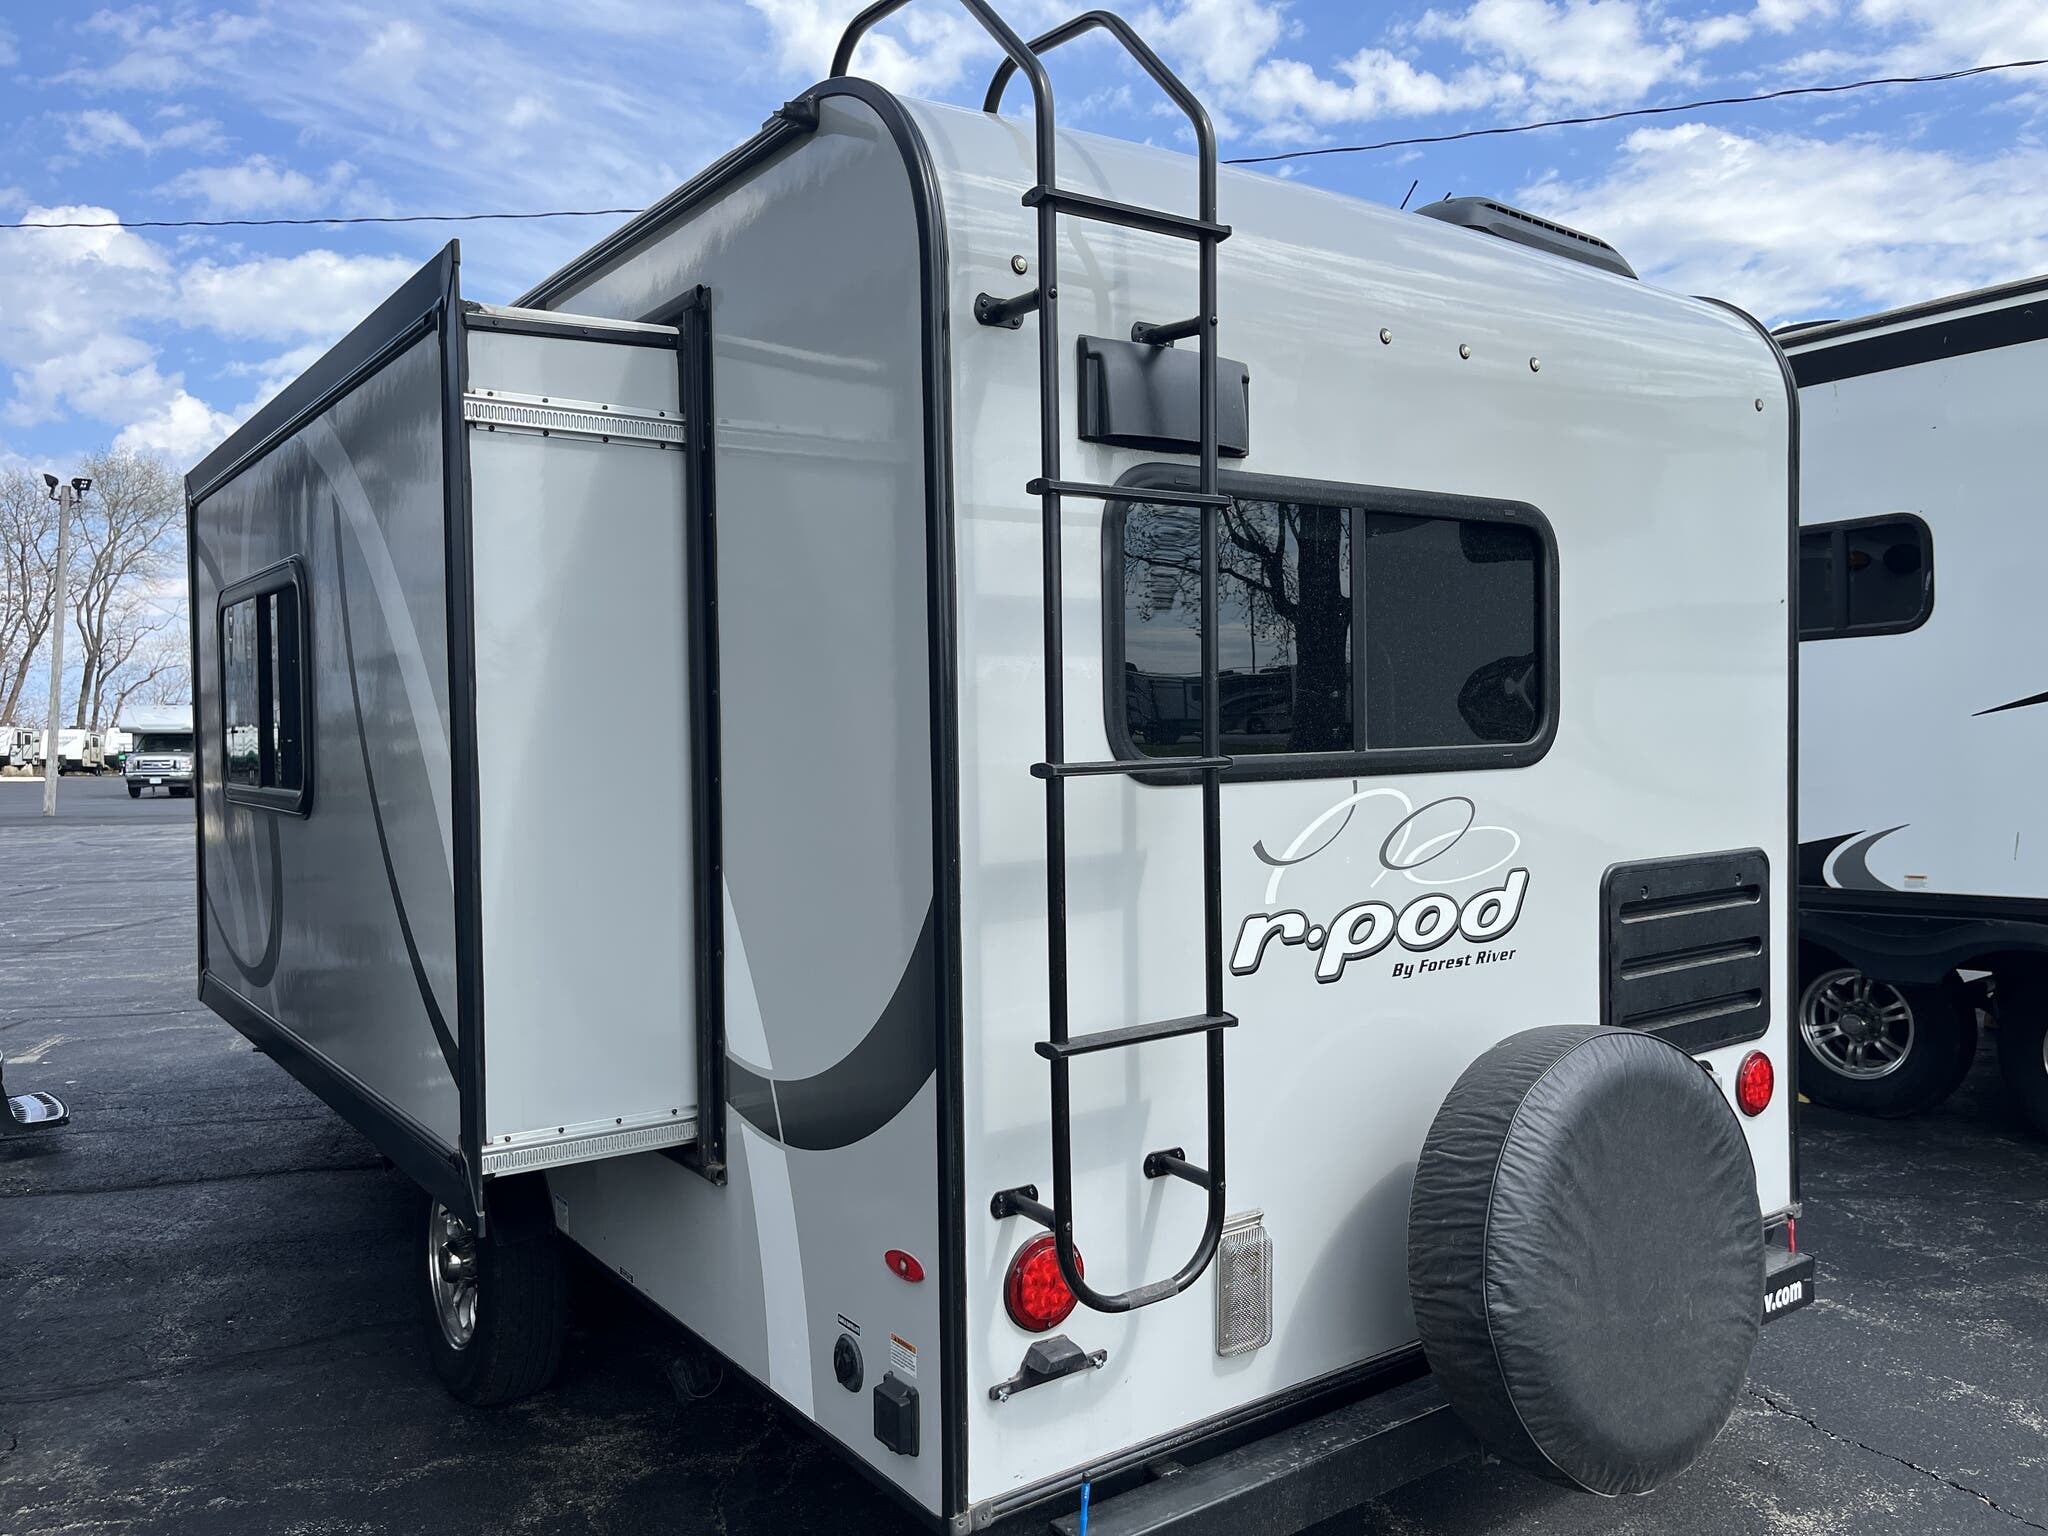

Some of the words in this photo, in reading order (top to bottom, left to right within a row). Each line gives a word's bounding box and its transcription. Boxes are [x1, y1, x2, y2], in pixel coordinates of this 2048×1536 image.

[1391, 962, 1415, 979] By
[1418, 954, 1472, 973] Forest
[1475, 949, 1517, 965] River
